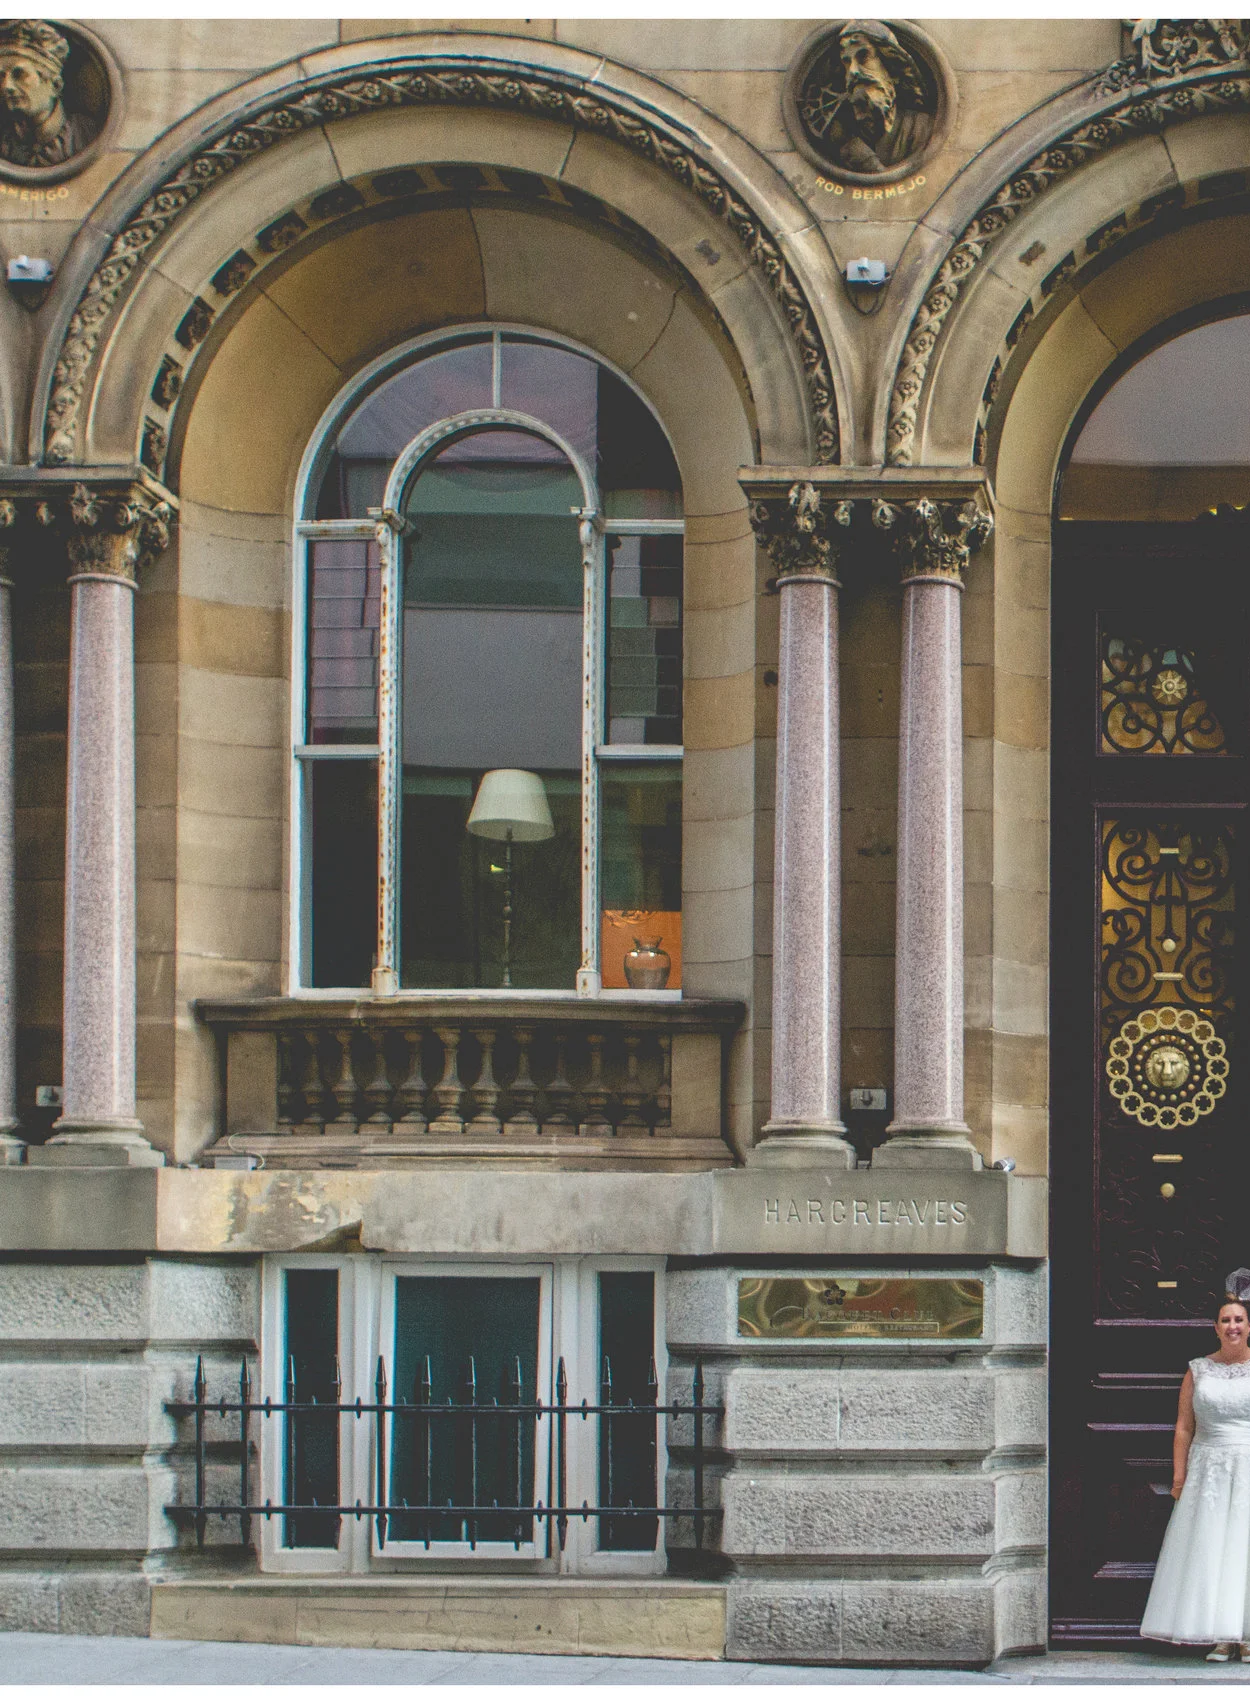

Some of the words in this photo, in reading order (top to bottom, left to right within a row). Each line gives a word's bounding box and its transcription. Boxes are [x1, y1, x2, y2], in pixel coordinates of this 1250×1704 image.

[815, 176, 844, 195] ROD
[852, 175, 926, 200] BERMEJO
[765, 1199, 968, 1226] HARGREAVES
